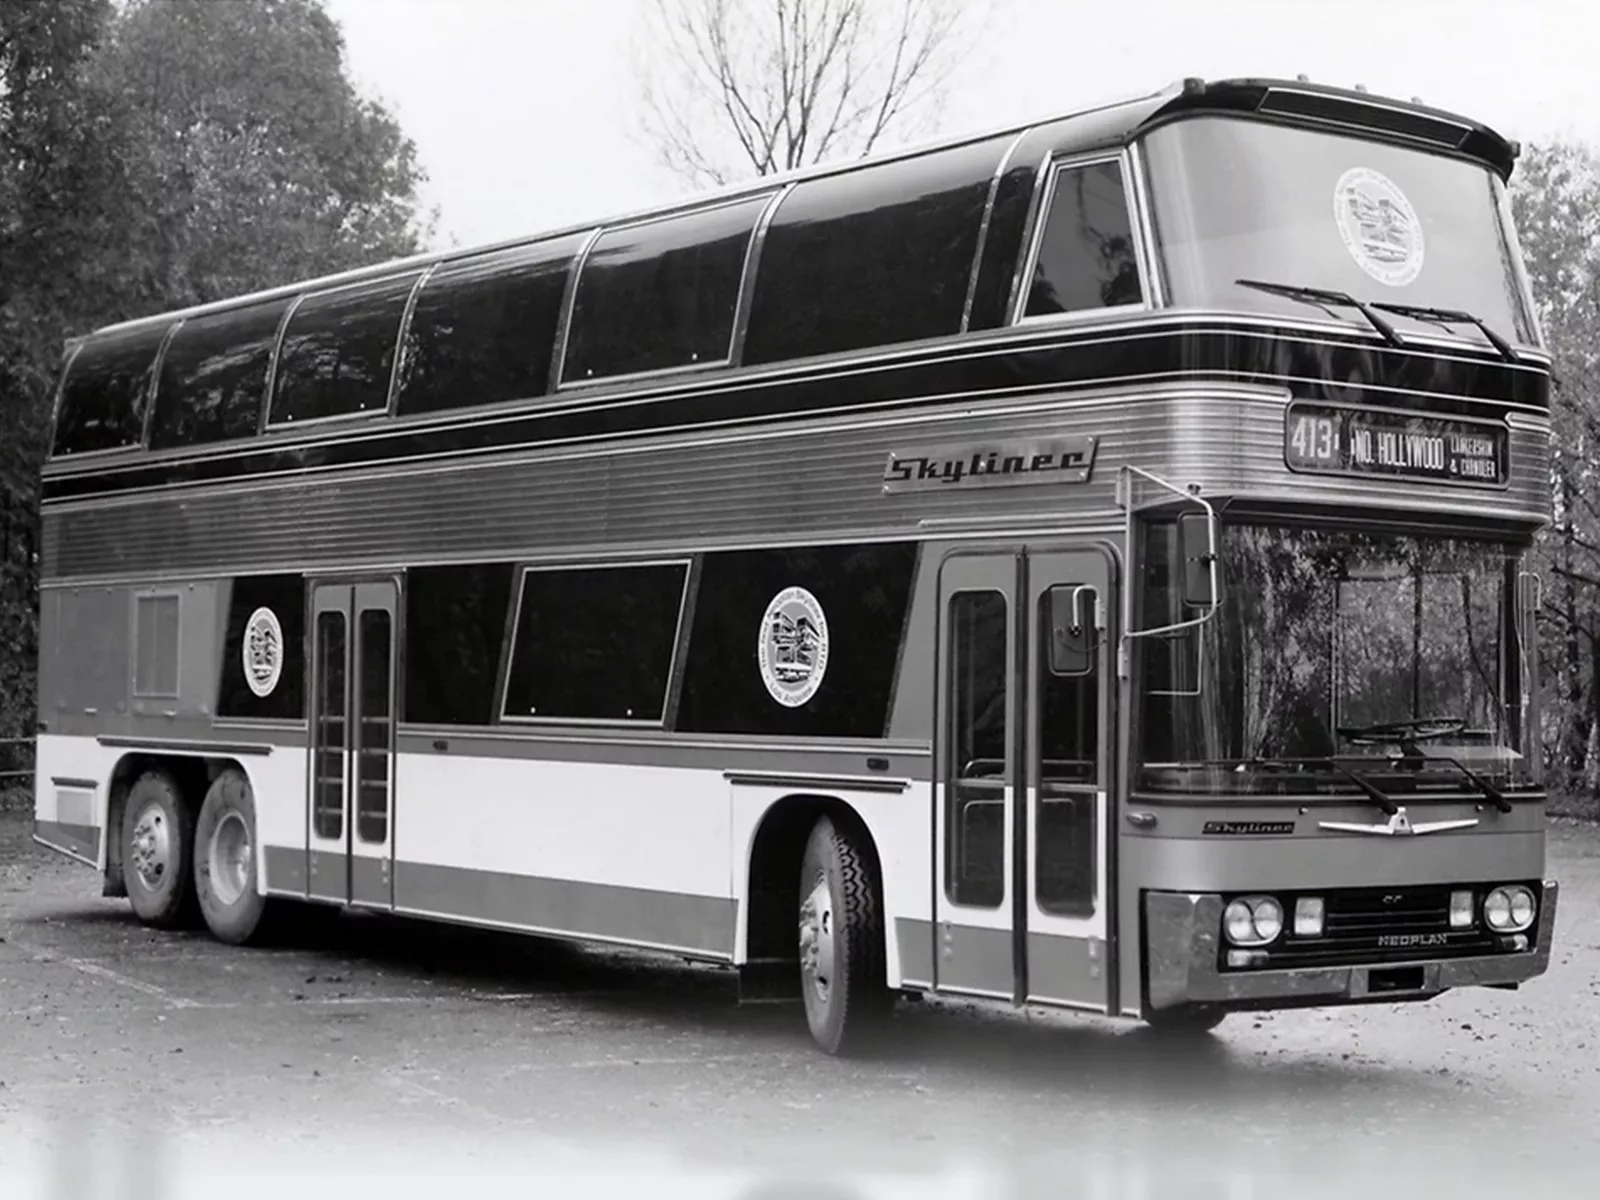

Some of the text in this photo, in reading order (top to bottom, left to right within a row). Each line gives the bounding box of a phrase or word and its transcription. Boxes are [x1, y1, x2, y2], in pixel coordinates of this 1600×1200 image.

[1292, 417, 1332, 459] 413
[1355, 430, 1444, 470] NO. HOLLYWOOD
[883, 452, 1090, 483] Skyliner
[1378, 933, 1447, 946] NEOPLAN
